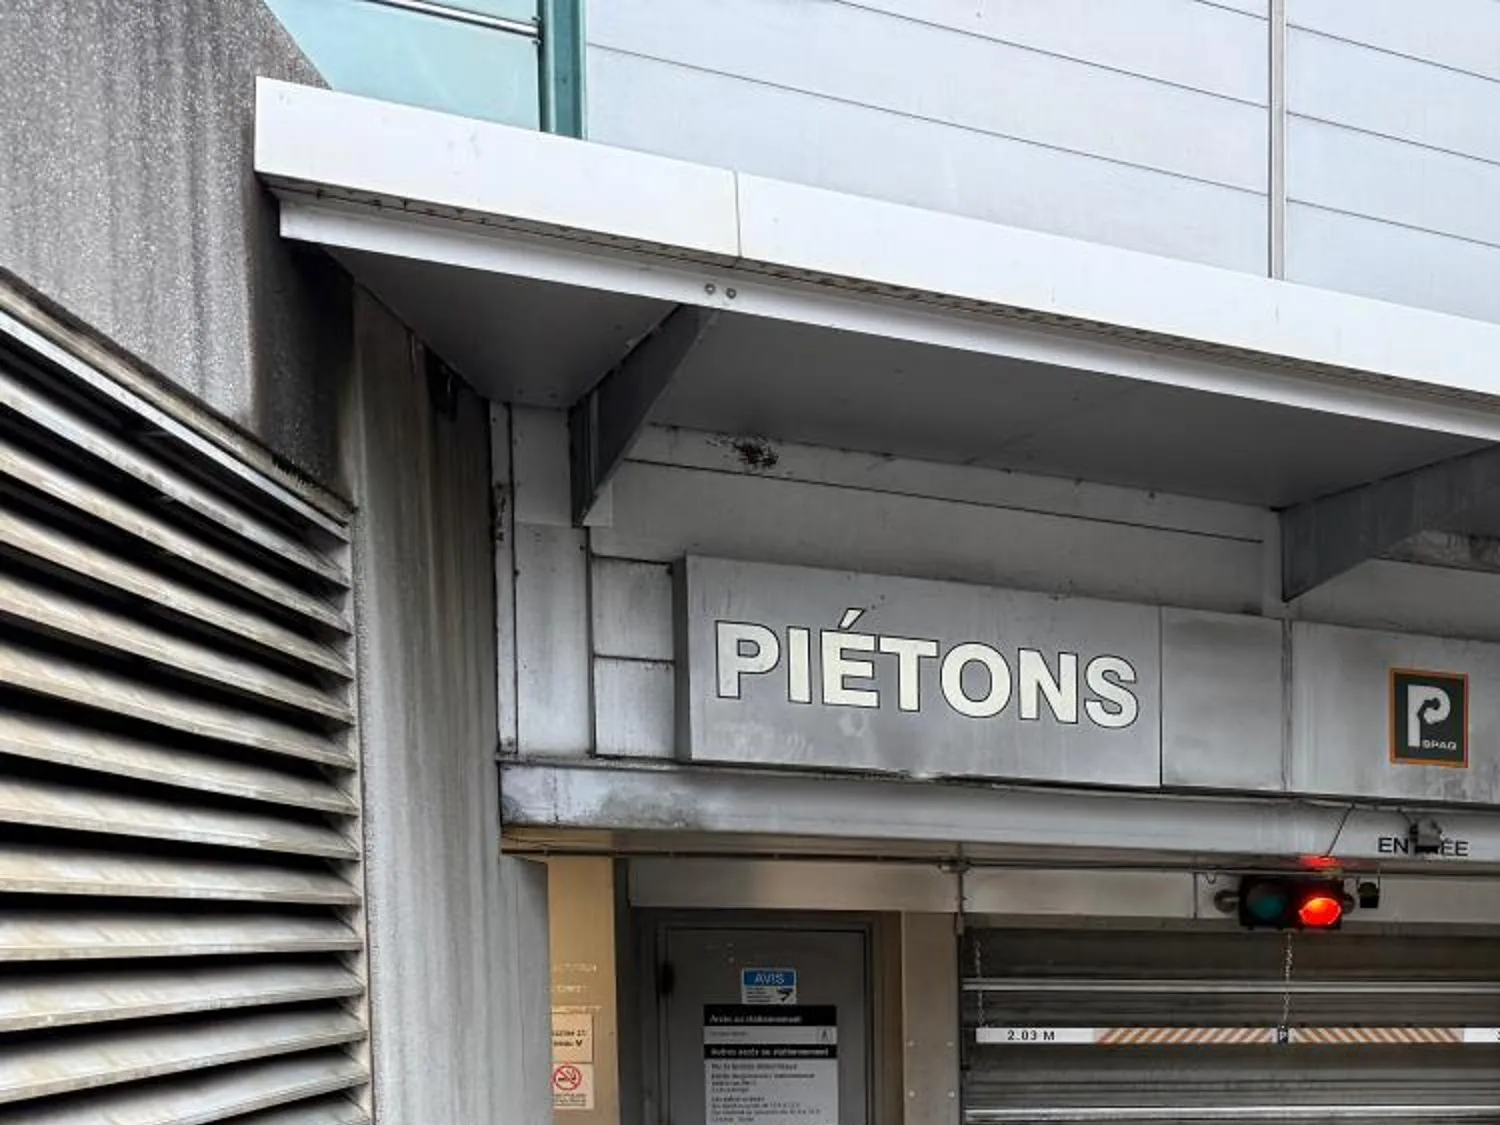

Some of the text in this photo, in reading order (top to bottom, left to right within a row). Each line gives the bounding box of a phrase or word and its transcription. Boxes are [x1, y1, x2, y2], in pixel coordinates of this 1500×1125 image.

[715, 608, 1139, 729] PIÉTONS
[1378, 837, 1469, 857] ENÉE
[755, 973, 785, 985] AVIS
[1007, 1030, 1055, 1041] 2.03 M
